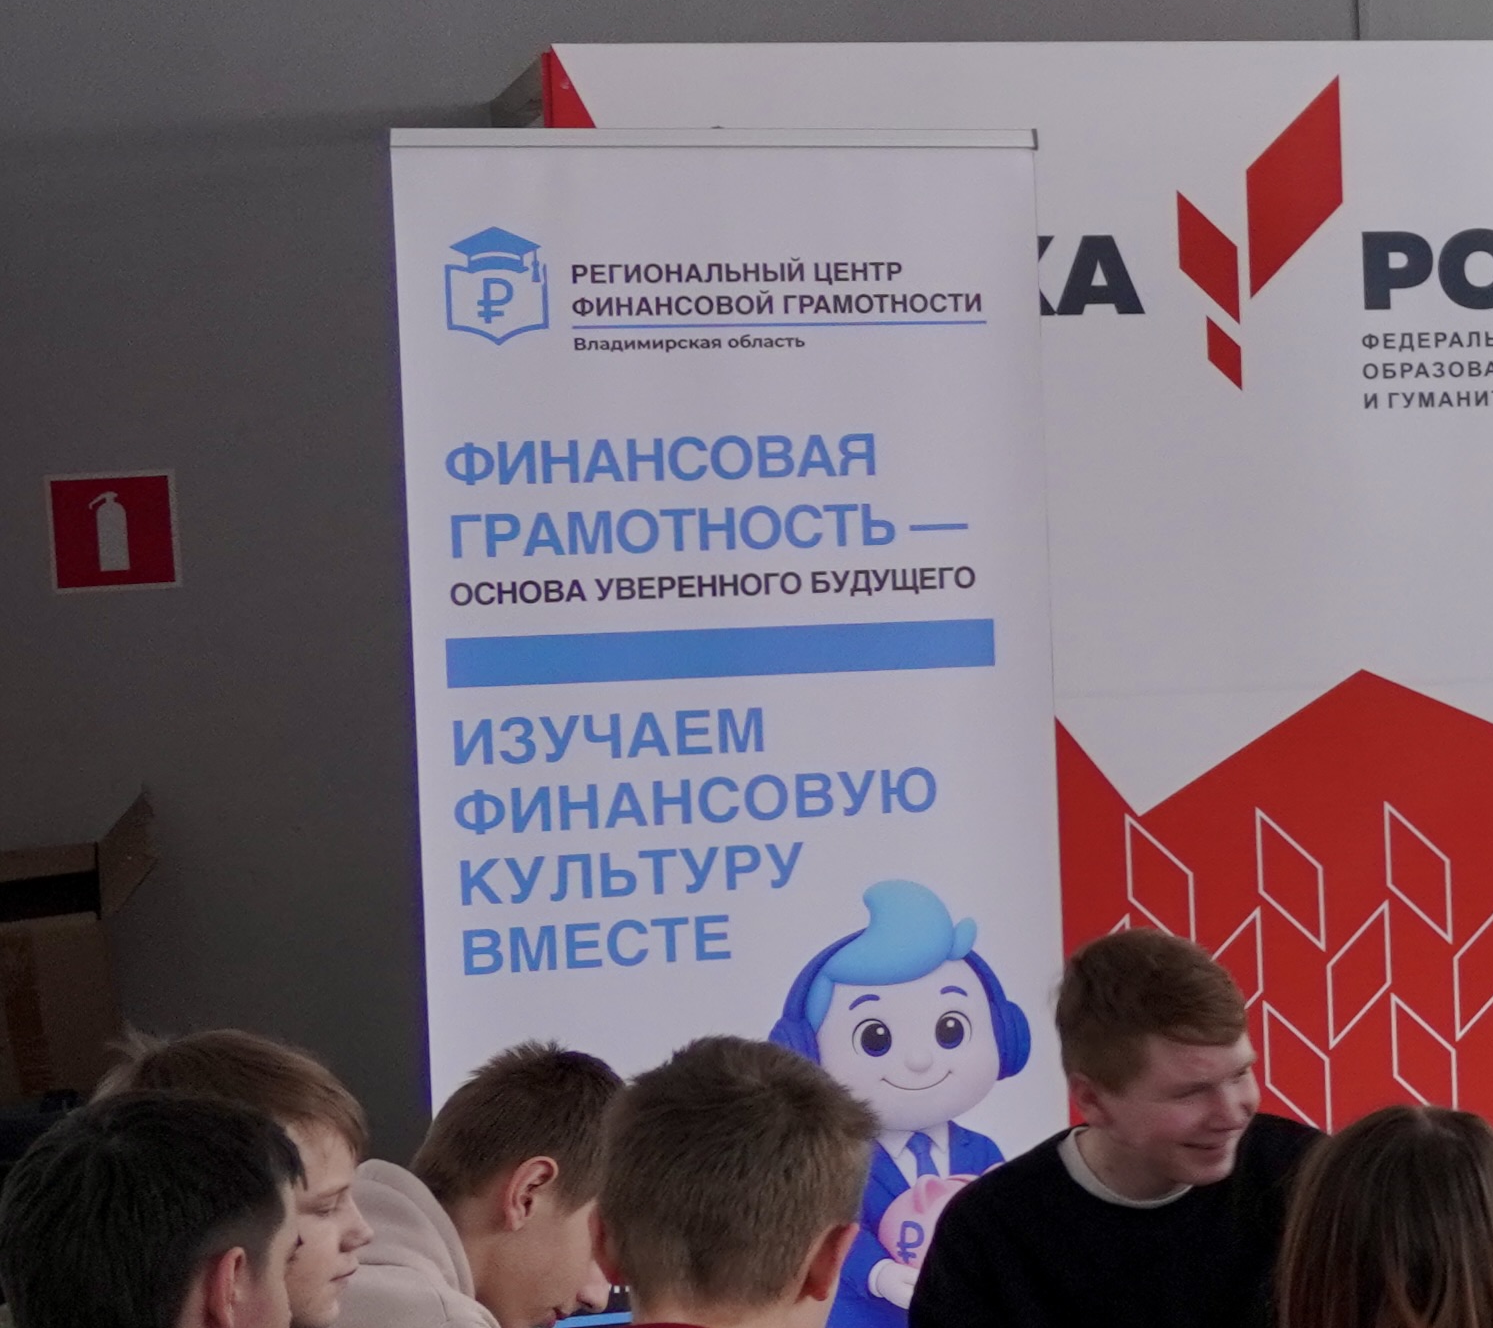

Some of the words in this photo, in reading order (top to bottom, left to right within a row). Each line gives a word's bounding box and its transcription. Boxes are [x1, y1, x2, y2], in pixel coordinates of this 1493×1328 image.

[571, 257, 804, 285] РЕГИОНАЛЬНЫЙ
[813, 261, 902, 285] ЦЕНТР
[571, 290, 773, 317] ФИНАНСОВОЙ
[783, 292, 981, 315] ГРАМОТНОСТИ
[574, 337, 722, 353] Владимирская
[728, 333, 806, 349] область
[1363, 393, 1378, 409] И
[445, 433, 875, 486] ФИНАНСОВАЯ
[451, 503, 896, 559] ГРАМОТНОСТЬ
[450, 578, 587, 606] ОСНОВА
[595, 571, 802, 601] УВЕРЕННОГО
[811, 565, 976, 597] БУДУЩЕГО
[453, 707, 764, 766] ИЗУЧАЕМ
[454, 767, 936, 835] ФИНАНСОВУЮ
[460, 841, 803, 905] КУЛЬТУРУ
[463, 914, 731, 976] ВМЕСТЕ
